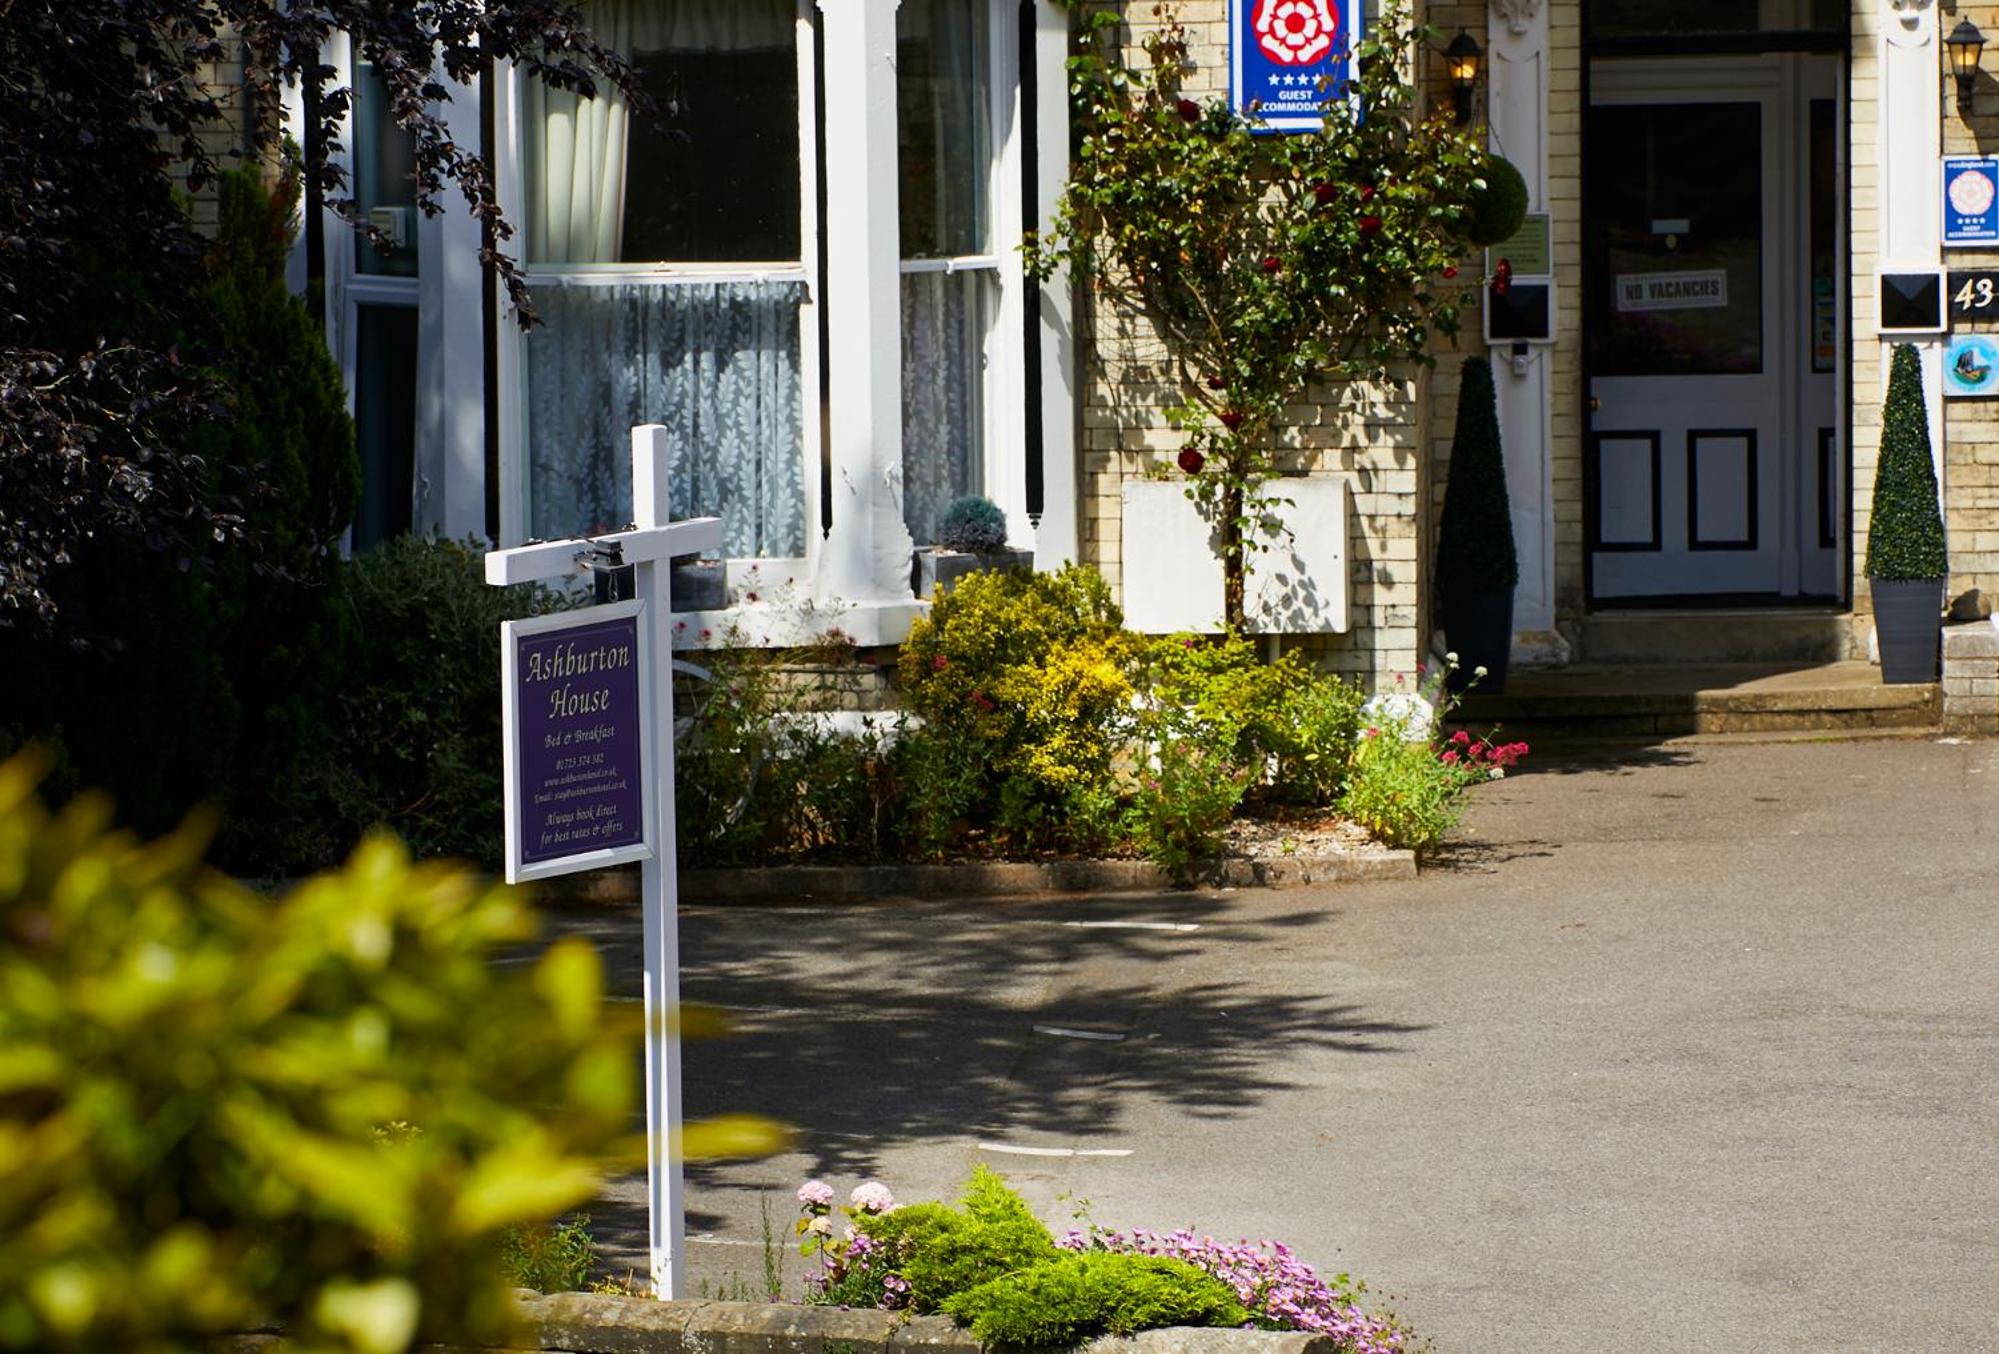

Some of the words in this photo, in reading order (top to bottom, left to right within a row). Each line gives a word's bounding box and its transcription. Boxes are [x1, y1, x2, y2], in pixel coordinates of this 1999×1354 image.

[1278, 90, 1313, 101] GUEST
[1625, 283, 1643, 301] NO
[1648, 279, 1720, 300] VACANCIES
[1954, 278, 1993, 311] 43
[525, 642, 629, 682] Ashburton
[549, 683, 609, 719] House
[545, 732, 561, 749] Bed
[575, 724, 615, 743] Breakfast
[545, 811, 574, 827] Always
[576, 805, 595, 820] book
[596, 804, 617, 817] direct
[540, 831, 553, 849] for
[554, 828, 569, 843] best
[571, 828, 590, 840] rates
[601, 819, 623, 838] offers
